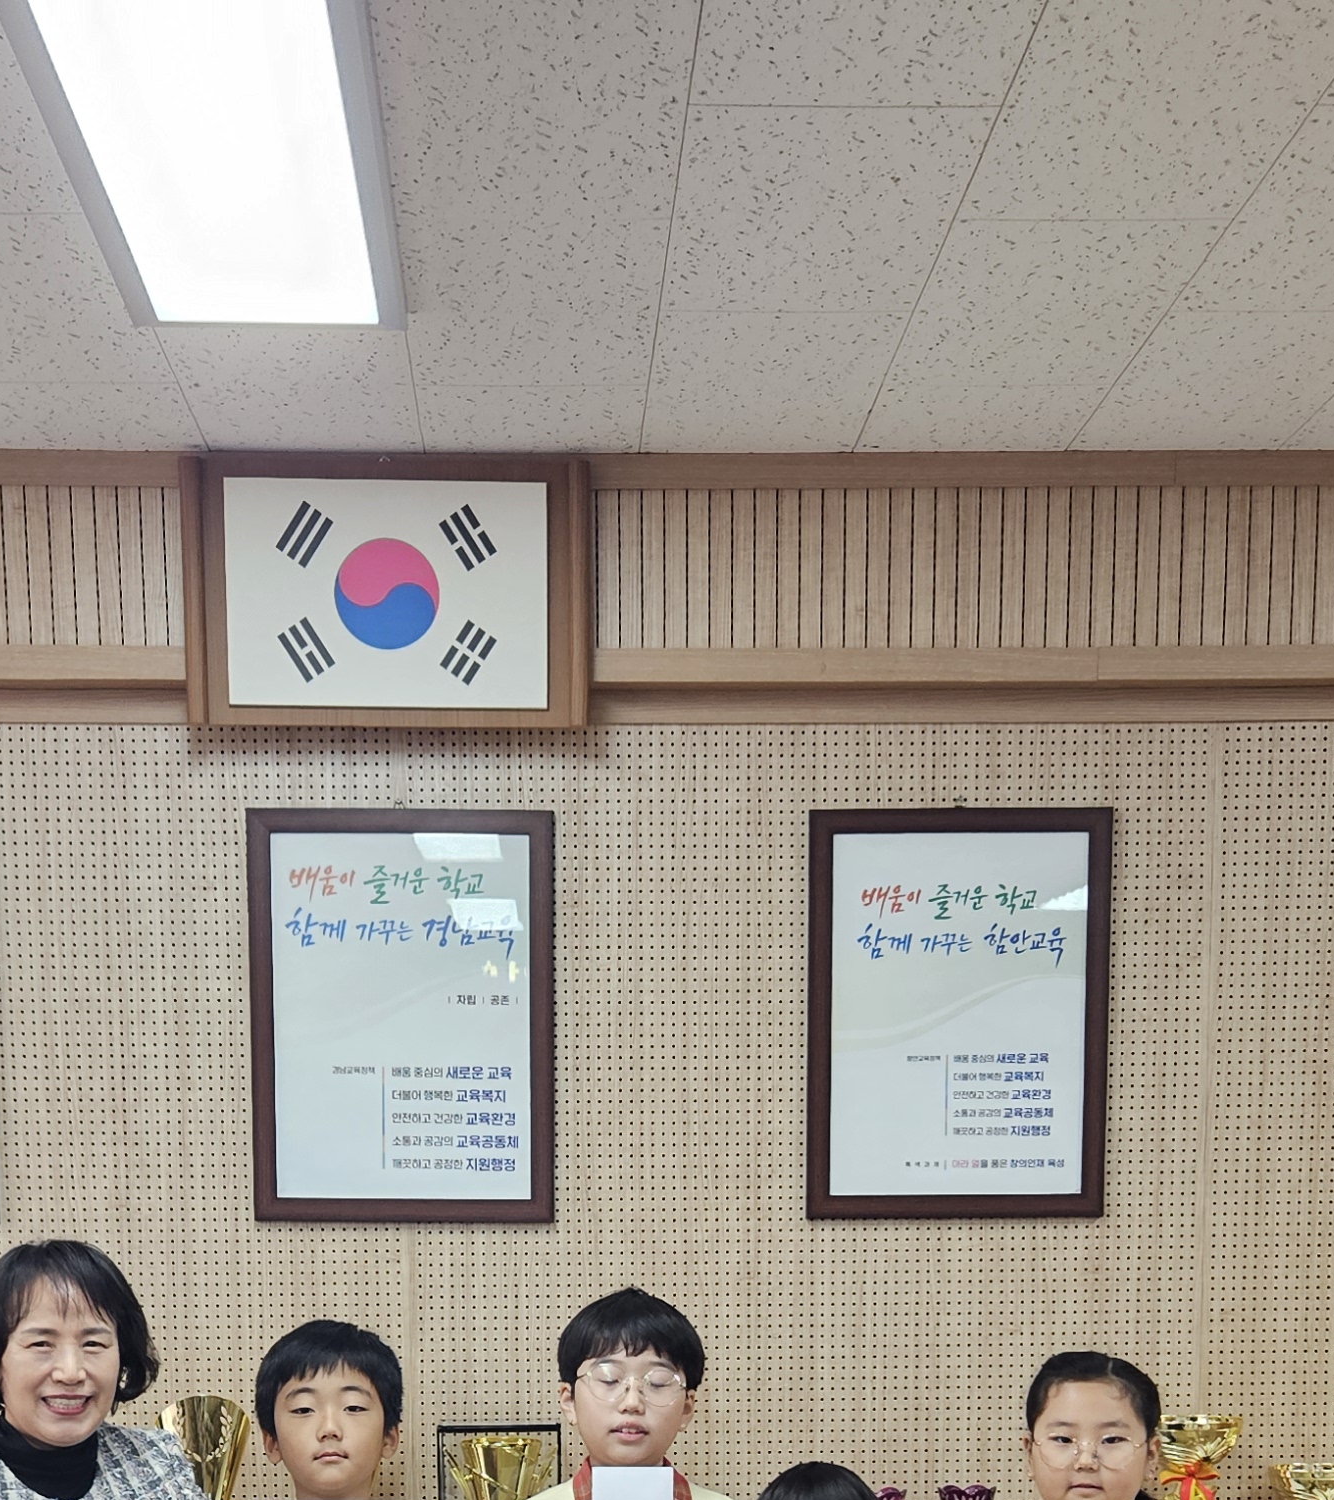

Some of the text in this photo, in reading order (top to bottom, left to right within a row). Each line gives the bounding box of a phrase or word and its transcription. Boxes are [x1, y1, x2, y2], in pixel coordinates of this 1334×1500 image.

[289, 865, 484, 904] 배움이 즐거운 학교
[862, 884, 1037, 920] 배움이 즐거운 학교
[285, 907, 347, 947] 함께
[356, 920, 413, 945] 가꾸는
[857, 923, 1067, 968] 함께 가꾸는 함안교육
[457, 995, 510, 1005] 자립 공존
[996, 1053, 1026, 1064] 새로운
[1029, 1053, 1049, 1063] 교육
[392, 1066, 512, 1079] 배움 중심의 새로운 교육
[1004, 1071, 1044, 1082] 교육복지
[392, 1089, 506, 1102] 더불어 행복한 교육복지
[1011, 1089, 1051, 1100] 교육환경
[392, 1112, 516, 1126] 안전하고 건강한 교육환경
[1003, 1108, 1054, 1118] 교육공동체
[1011, 1126, 1051, 1136] 지원행정
[392, 1135, 519, 1148] 소통과 공감의 교육공동체
[392, 1158, 516, 1171] 깨끗하고 공정한 지원행정
